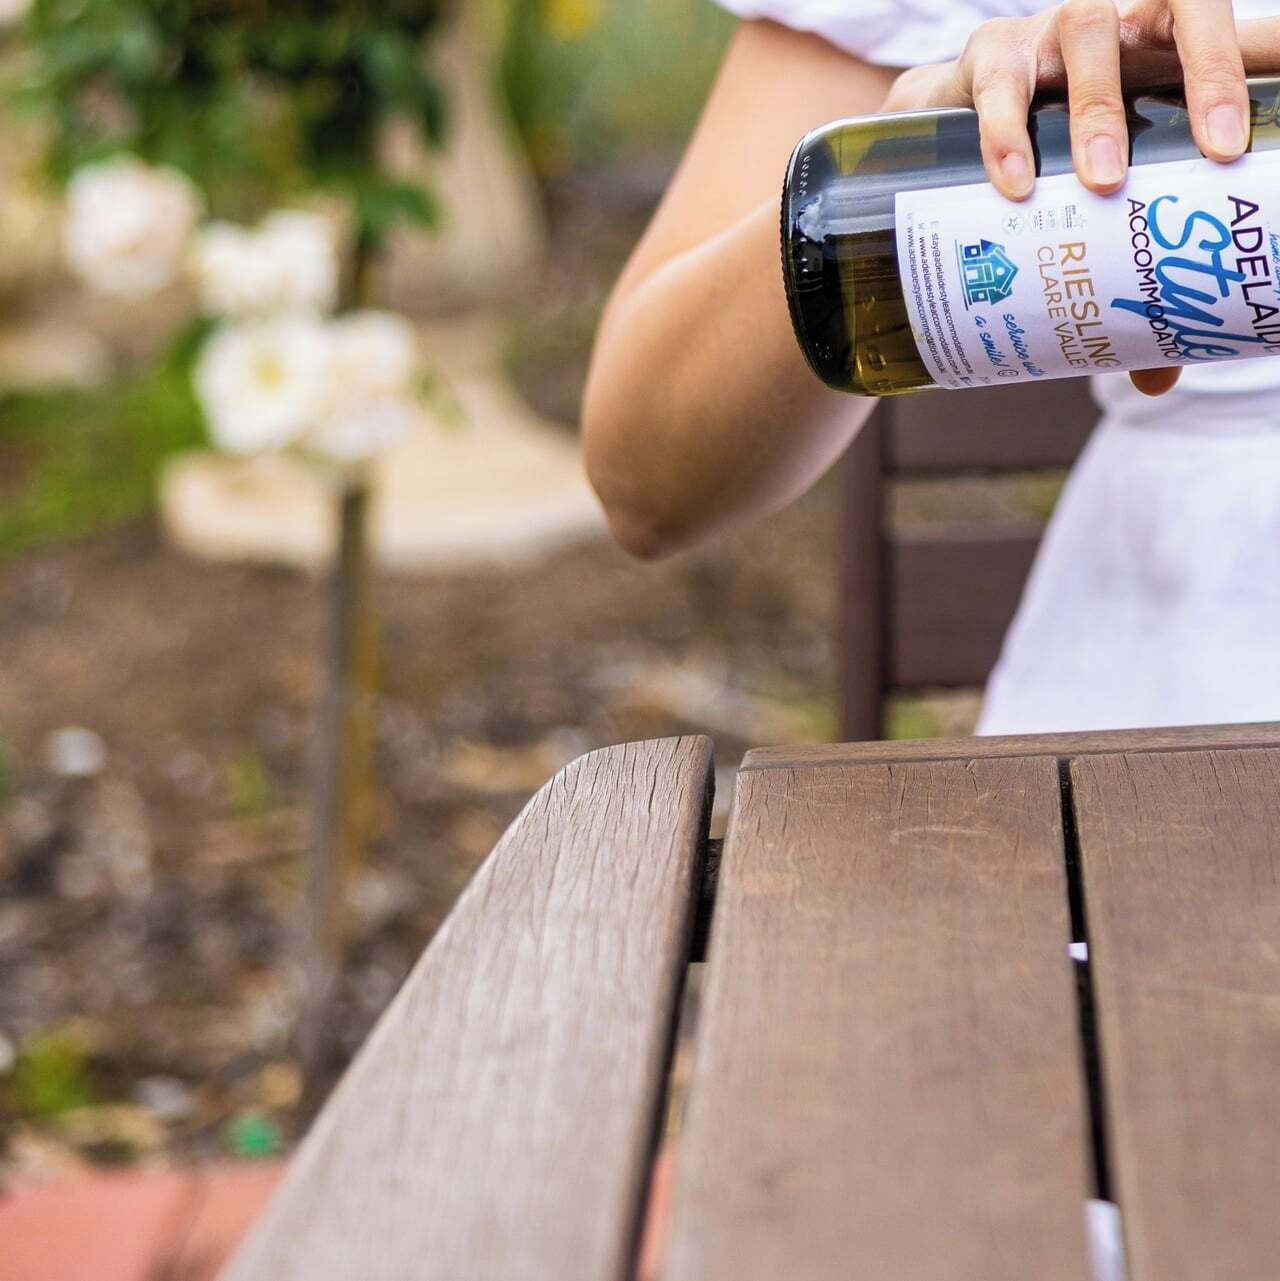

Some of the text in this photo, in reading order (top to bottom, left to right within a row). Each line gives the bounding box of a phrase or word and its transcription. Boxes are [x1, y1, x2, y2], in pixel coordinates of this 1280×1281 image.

[1037, 246, 1067, 319] CLARE
[1059, 241, 1122, 368] RIESLING
[1111, 195, 1265, 360] Style
[1003, 313, 1029, 360] service
